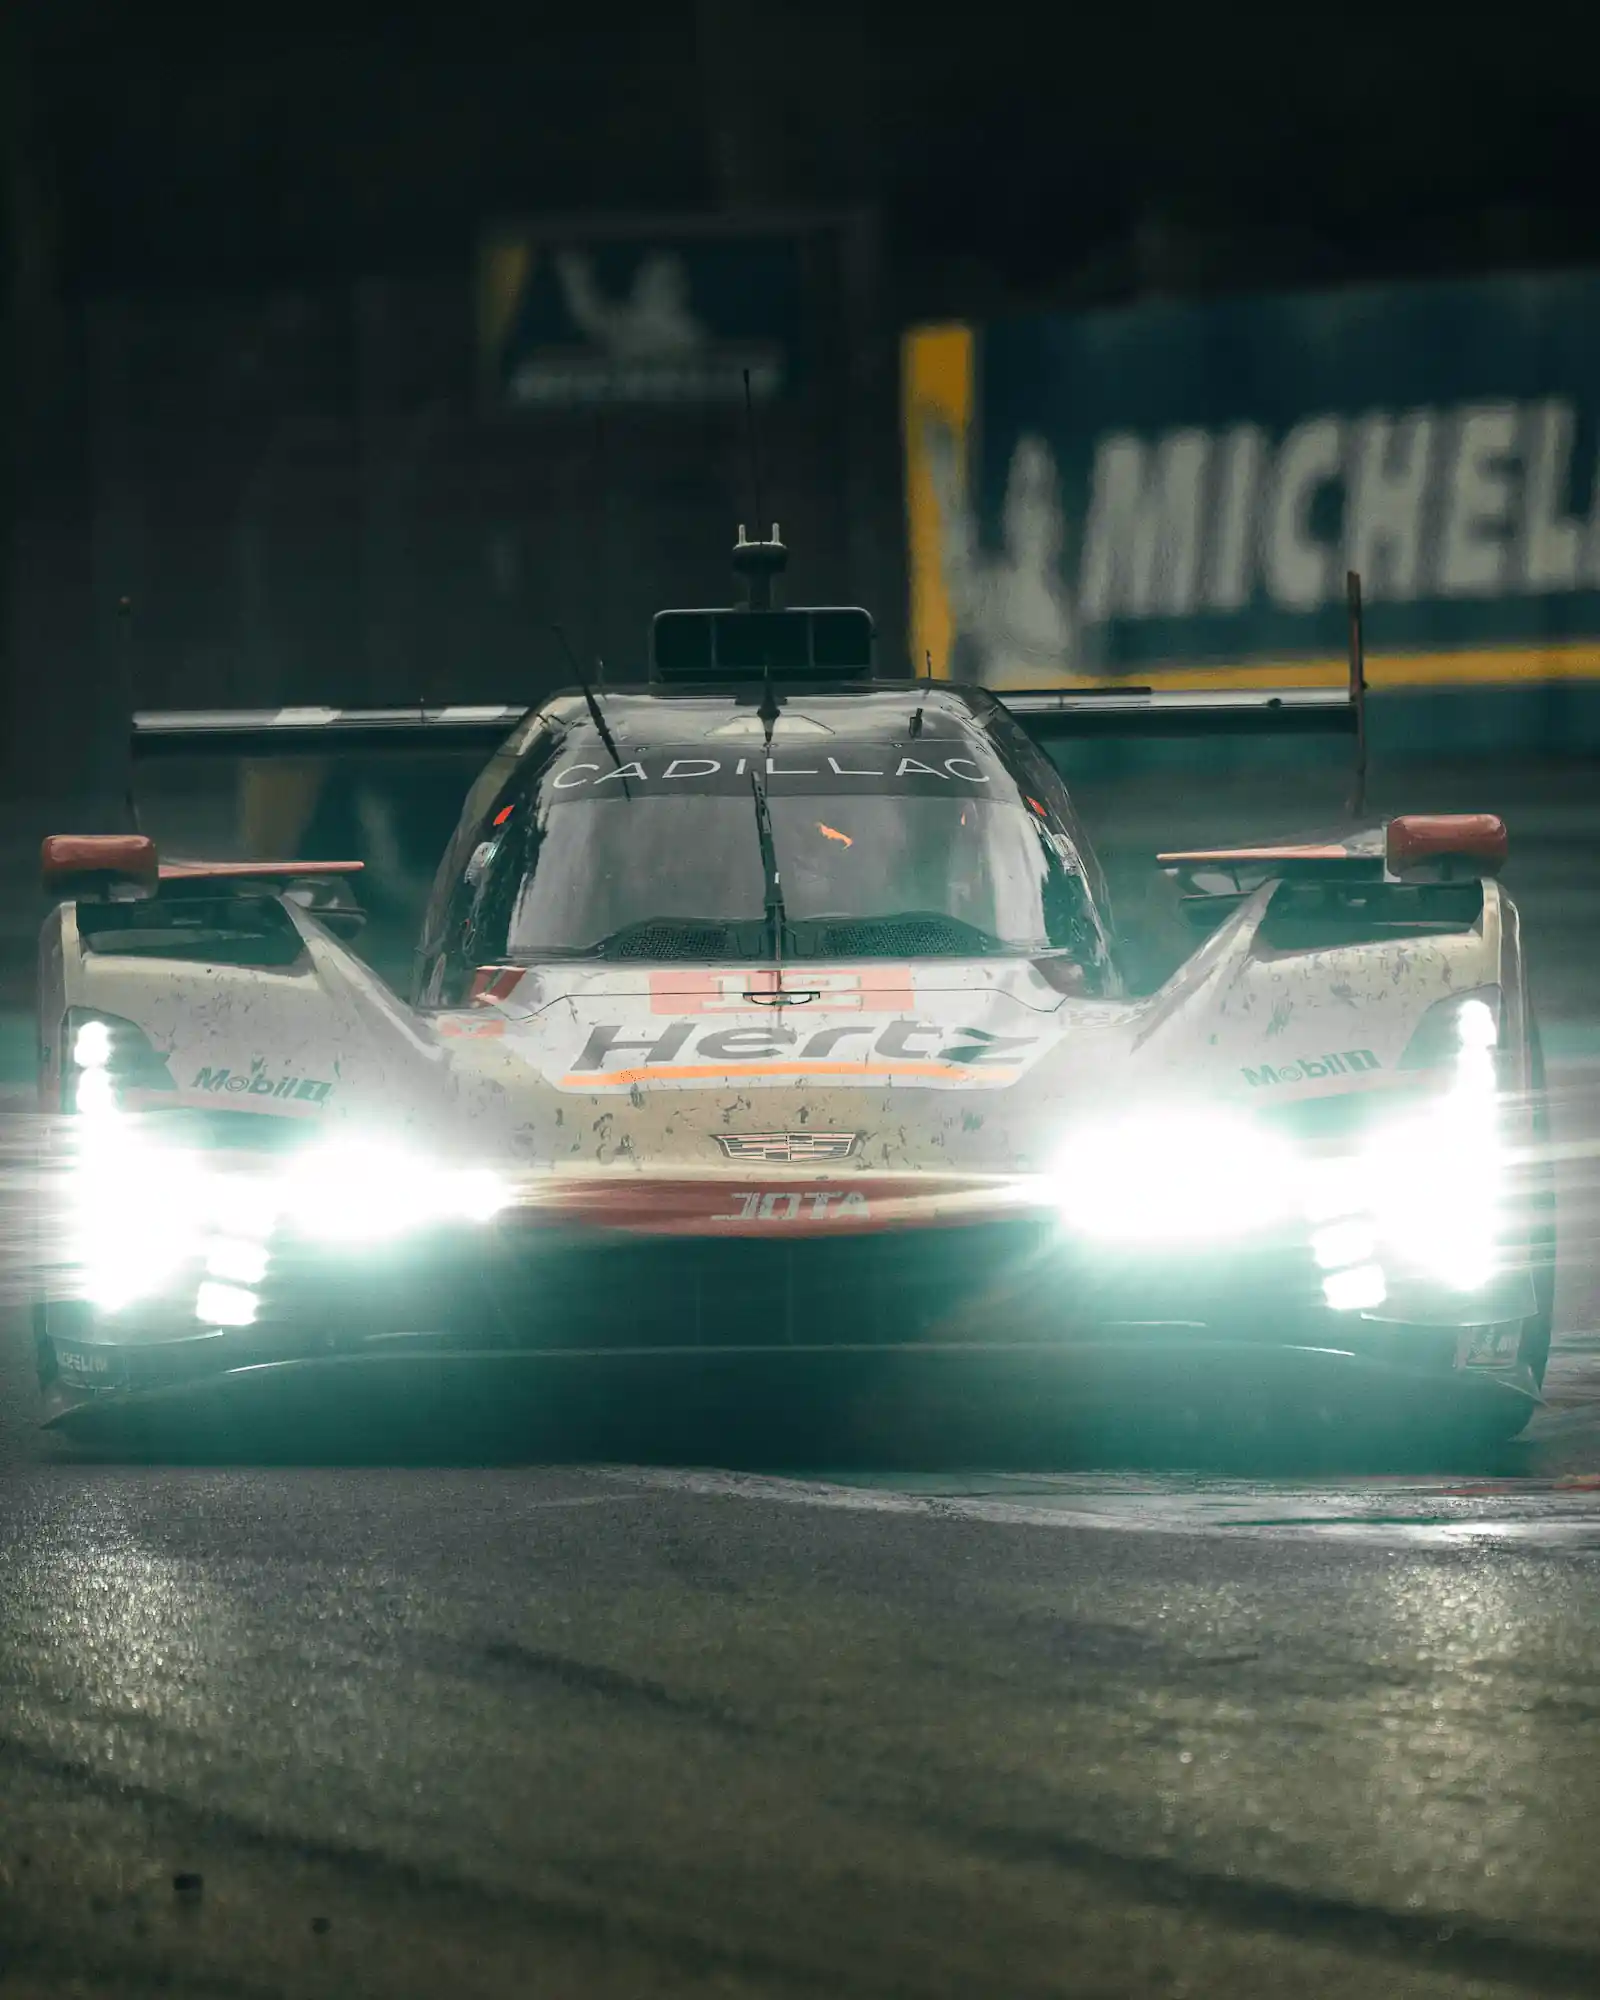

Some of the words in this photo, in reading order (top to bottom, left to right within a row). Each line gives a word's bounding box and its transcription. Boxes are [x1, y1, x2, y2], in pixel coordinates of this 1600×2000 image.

[1082, 402, 1600, 618] MICHEL
[552, 756, 991, 789] CADILLAC
[569, 1019, 1039, 1071] Hertz
[710, 1191, 871, 1221] JOTA
